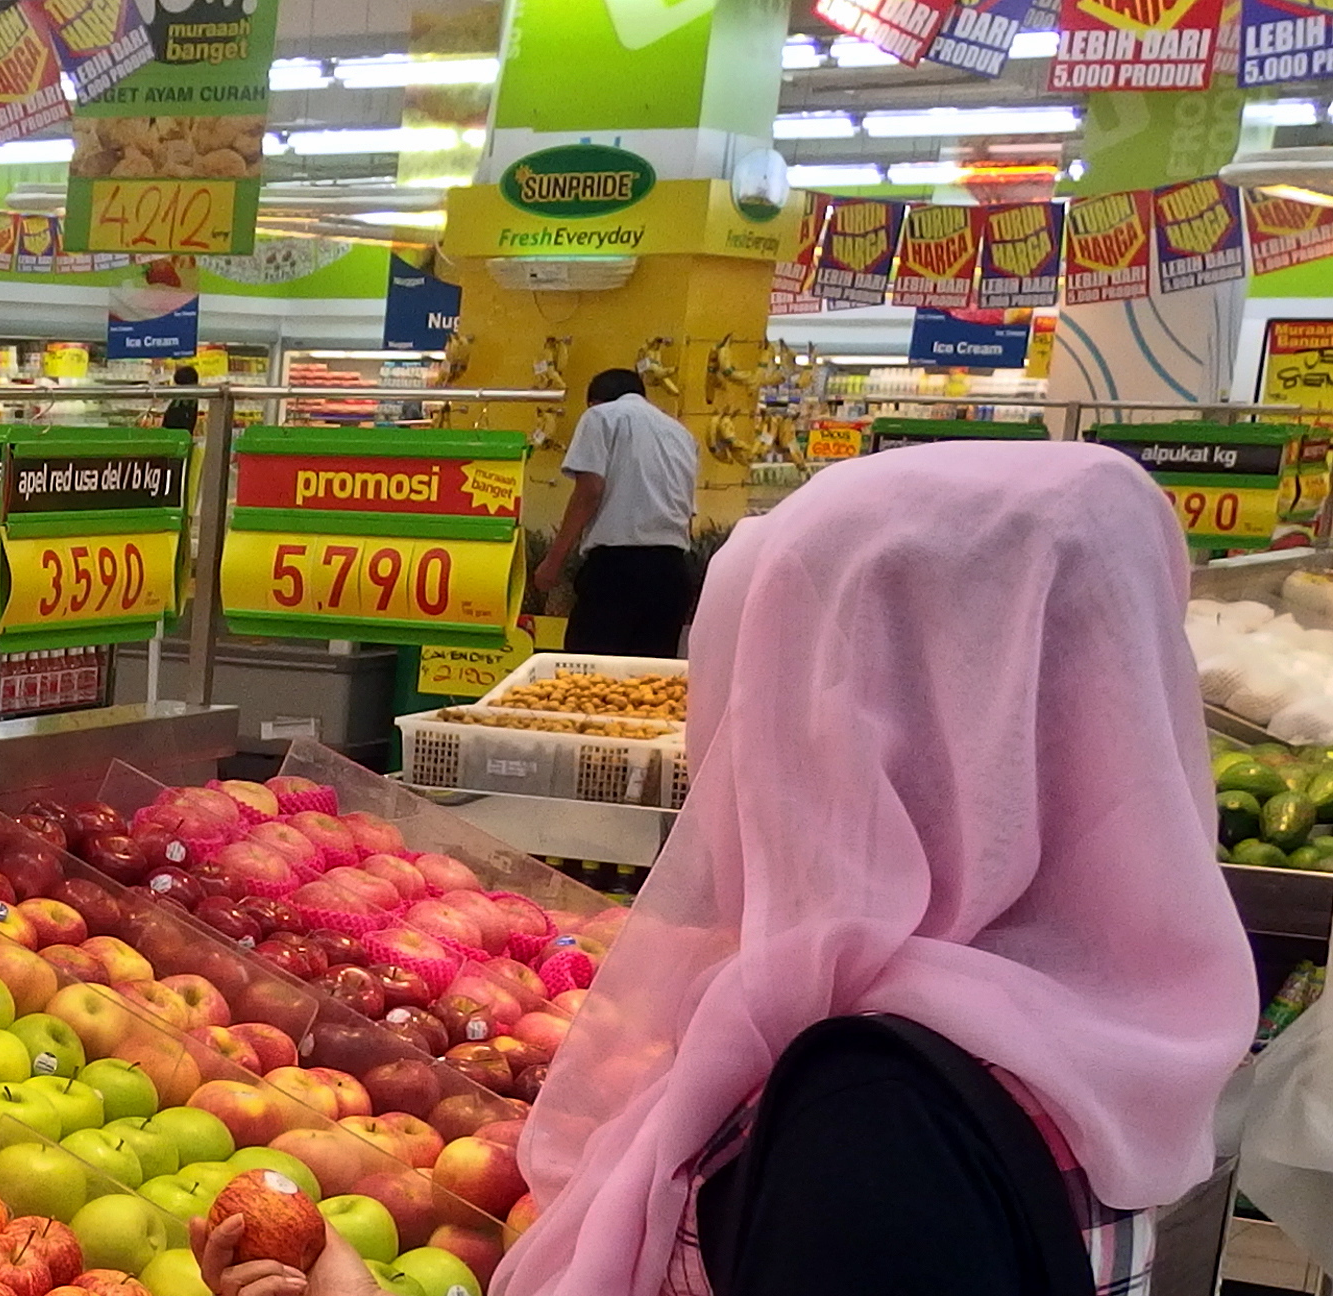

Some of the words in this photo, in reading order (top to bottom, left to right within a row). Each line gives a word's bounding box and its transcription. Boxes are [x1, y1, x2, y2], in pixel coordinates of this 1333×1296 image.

[168, 20, 250, 38] muraaah
[879, 0, 940, 40] DARI
[953, 7, 1020, 50] DARI
[1245, 14, 1327, 57] LEBIH
[74, 49, 110, 89] LEBIH
[109, 24, 151, 65] DARI
[166, 39, 249, 65] banget
[929, 36, 1008, 76] PRODUK
[1057, 29, 1137, 62] LEBIH
[1140, 27, 1213, 61] DARI
[109, 43, 156, 87] PRODUK
[1052, 64, 1116, 88] 5.000
[1117, 62, 1206, 88] PRODUK
[1244, 52, 1309, 86] 5.000
[24, 83, 63, 113] DARI
[145, 87, 194, 102] AYAM
[199, 84, 268, 102] CURAH
[19, 104, 69, 139] PRODUK
[520, 171, 634, 203] SUNPRIDE
[1160, 179, 1221, 223] TURUN
[835, 202, 885, 235] TURUN
[911, 205, 966, 240] TURUN
[989, 204, 1047, 241] TURUN
[1073, 193, 1132, 236] TURUN
[1165, 203, 1231, 254] HARGA
[833, 226, 888, 271] HARGA
[910, 232, 968, 276] HARGA
[991, 229, 1053, 277] HARGA
[1077, 220, 1141, 269] HARGA
[125, 337, 141, 348] Ice
[144, 335, 180, 348] Cream
[932, 341, 955, 354] Ice
[956, 341, 1004, 356] Cream
[1141, 444, 1210, 466] alpukat
[1214, 446, 1238, 468] kg
[17, 464, 49, 500] apel
[50, 463, 73, 492] red
[74, 467, 98, 491] usa
[100, 461, 123, 490] del
[143, 459, 161, 497] kg
[295, 464, 441, 506] promosi
[470, 477, 515, 500] banget
[270, 543, 453, 617] 5,790
